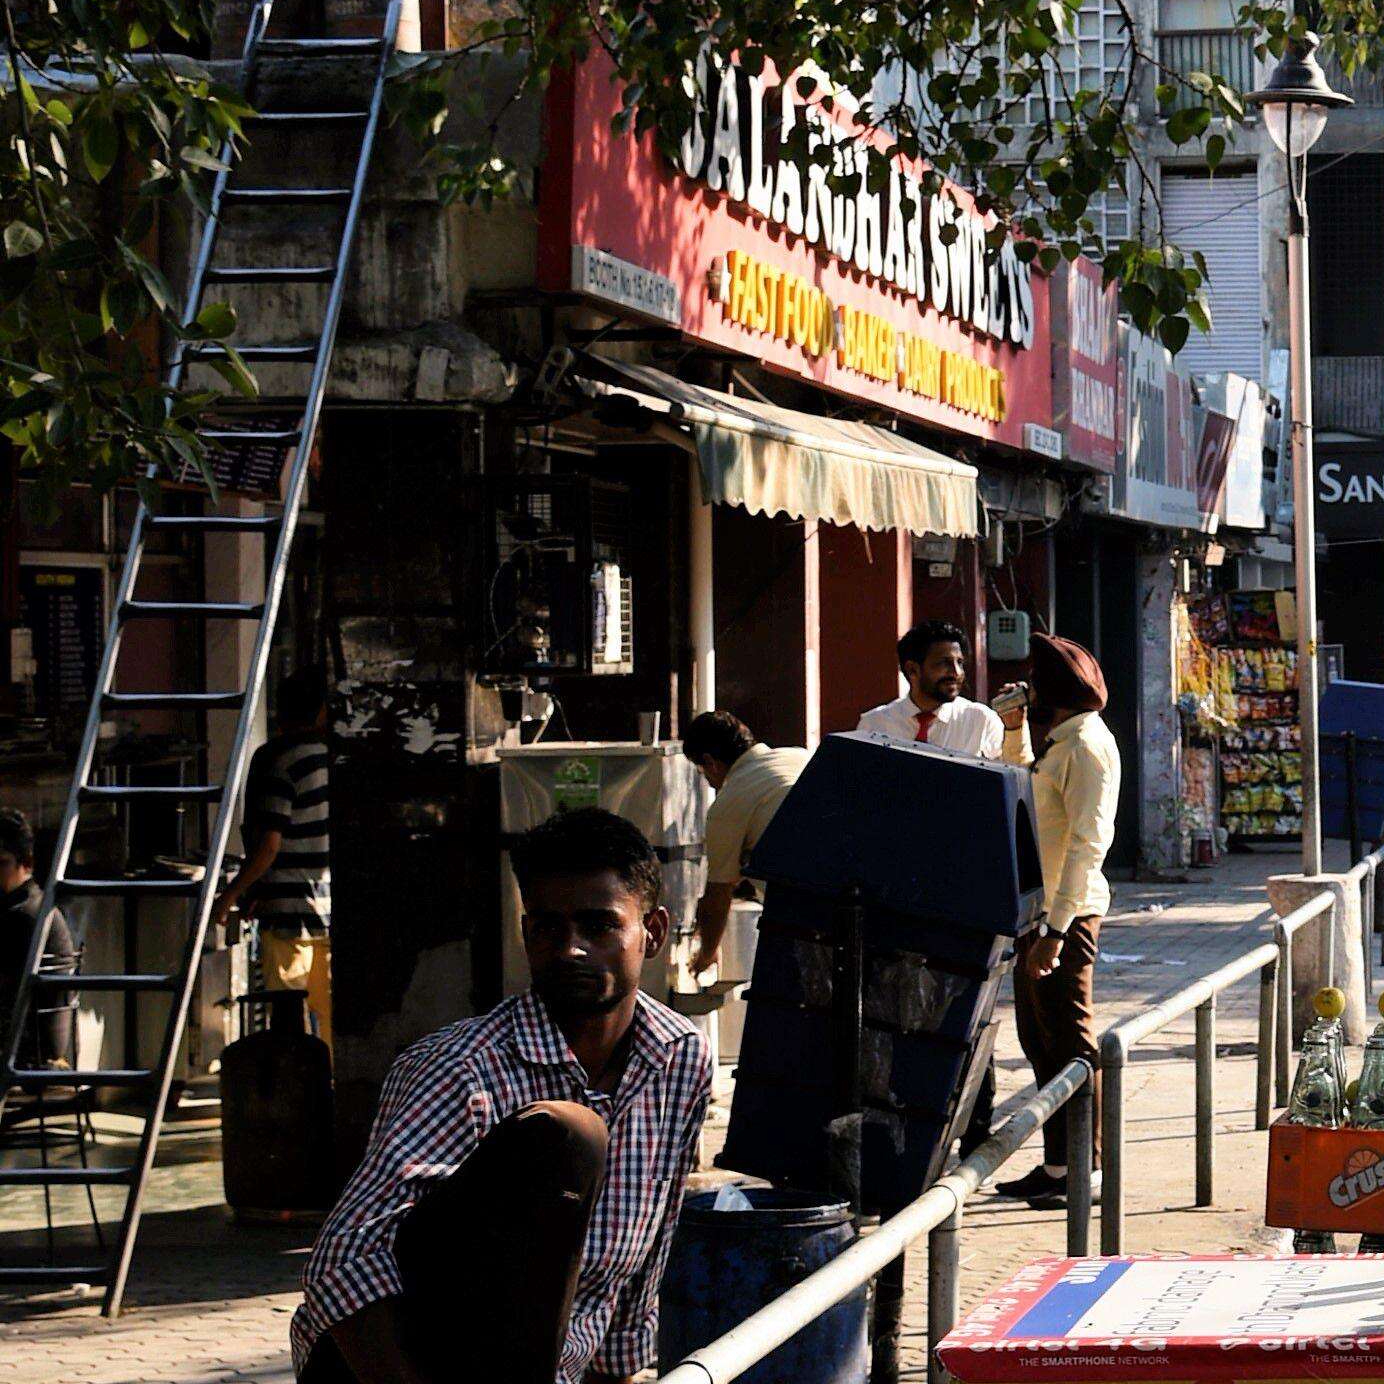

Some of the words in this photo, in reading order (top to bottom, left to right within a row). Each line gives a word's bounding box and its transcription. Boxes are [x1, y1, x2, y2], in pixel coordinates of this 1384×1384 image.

[731, 250, 781, 333] FAST
[1019, 1357, 1040, 1367] THE
[1041, 1355, 1117, 1367] SMARTPHONE
[1118, 1355, 1169, 1365] NETWORK
